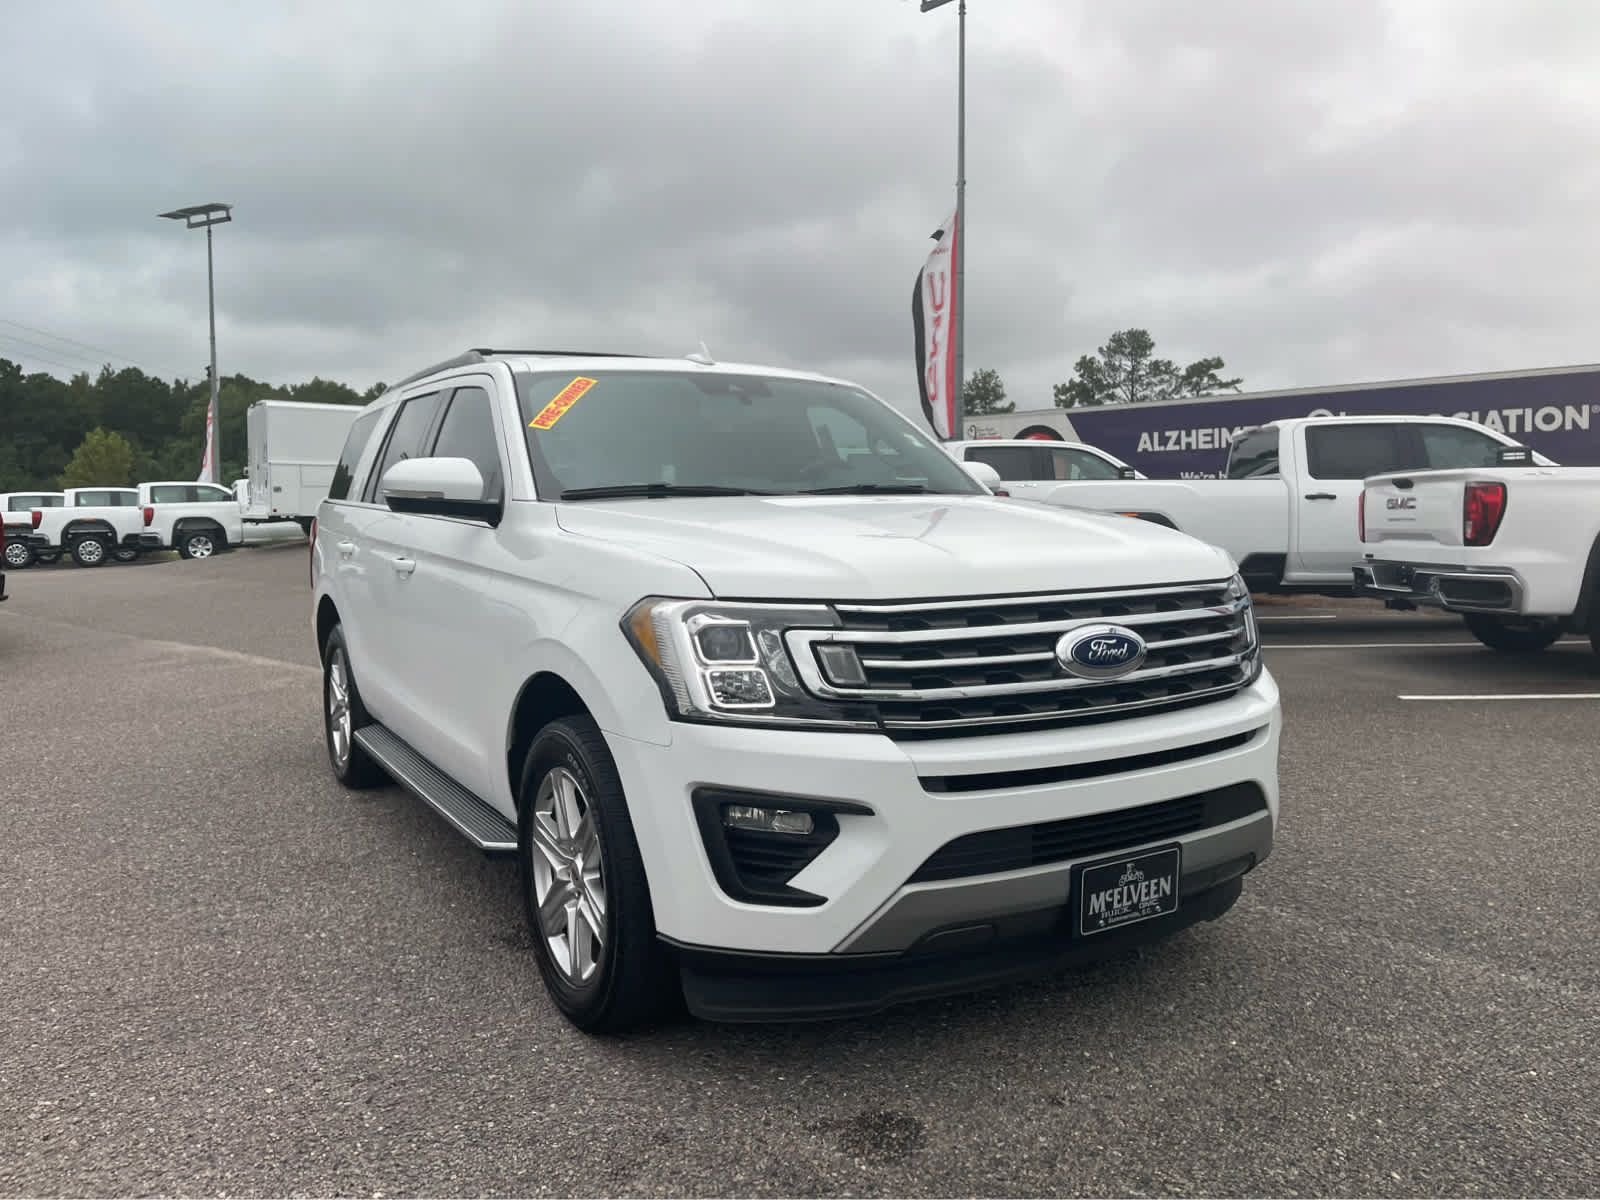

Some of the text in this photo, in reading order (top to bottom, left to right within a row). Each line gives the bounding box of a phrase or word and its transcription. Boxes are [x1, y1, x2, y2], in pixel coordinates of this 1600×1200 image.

[533, 380, 593, 427] PRE-OWNED
[1386, 497, 1416, 510] GMC
[1088, 638, 1128, 660] Ford
